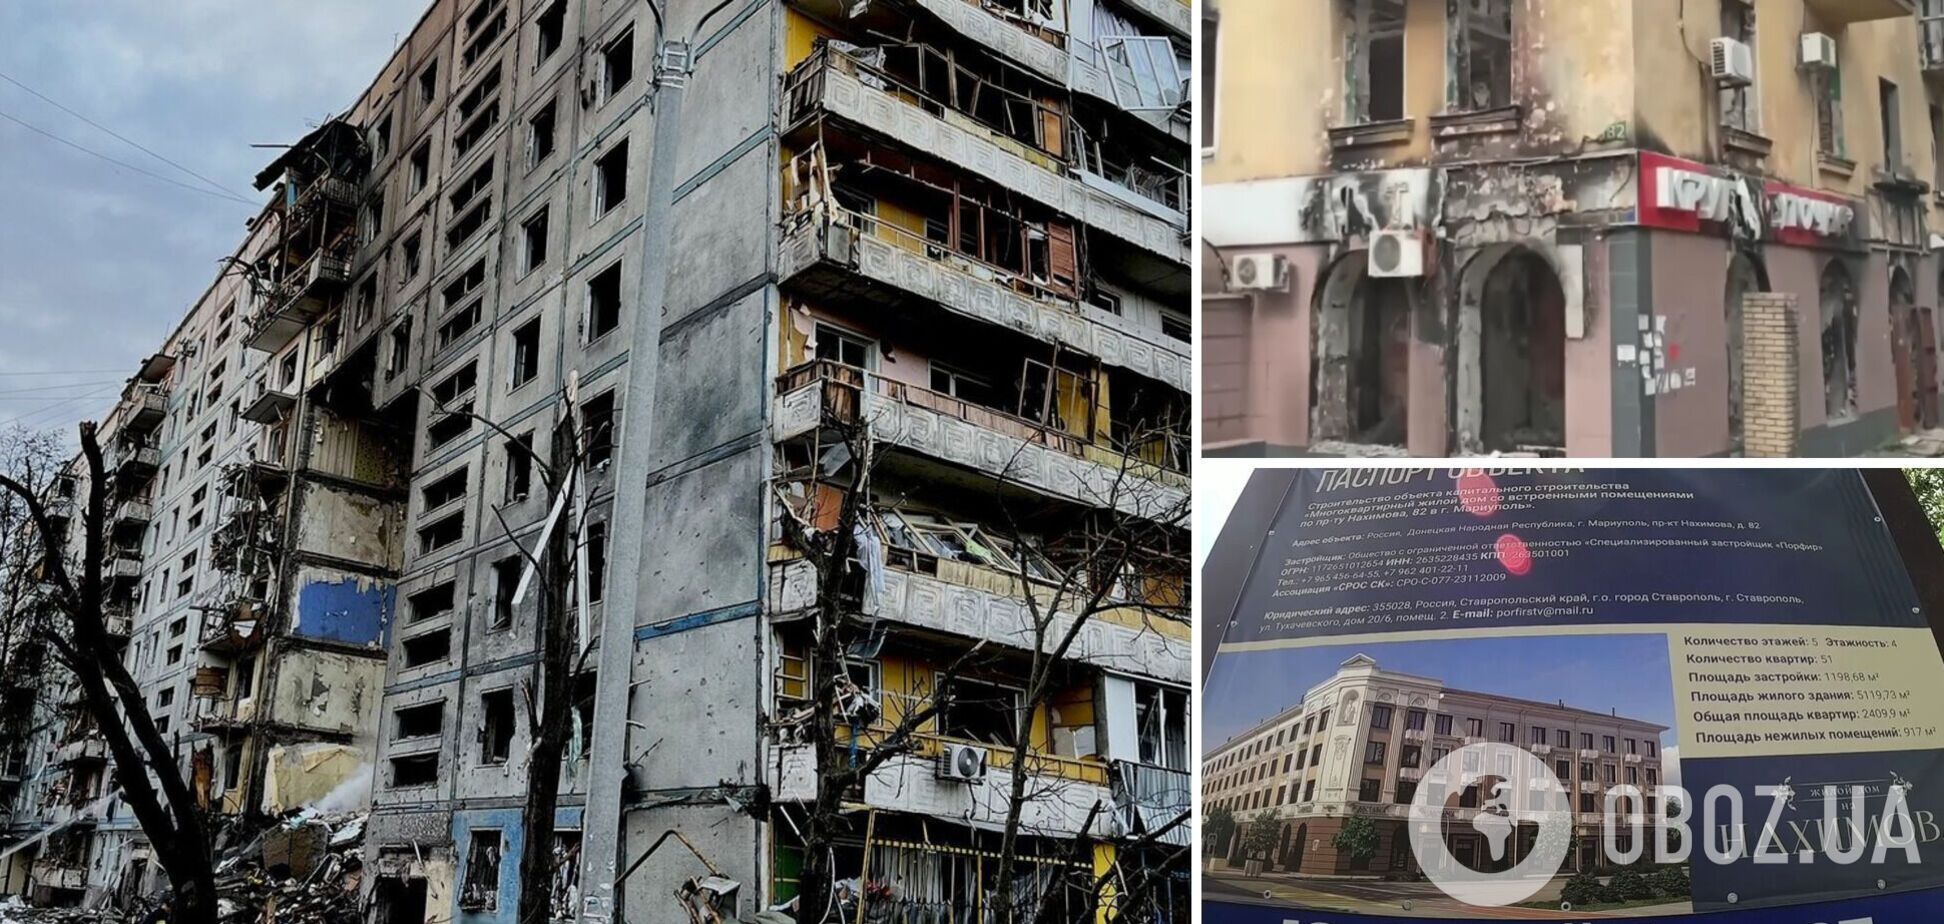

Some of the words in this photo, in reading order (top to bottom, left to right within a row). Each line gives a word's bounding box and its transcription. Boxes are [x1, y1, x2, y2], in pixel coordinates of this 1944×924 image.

[1607, 124, 1625, 139] 82
[1316, 468, 1437, 493] ПАСПОРТ
[1304, 500, 1416, 518] «Многоквартирный
[1418, 495, 1458, 507] жилой
[1462, 496, 1487, 506] дом
[1490, 494, 1505, 502] со
[1508, 490, 1598, 502] встроенными
[1600, 490, 1695, 500] помещениями
[1307, 493, 1392, 511] Строительство
[1394, 489, 1443, 503] объекта
[1446, 485, 1532, 497] капитального
[1535, 482, 1630, 493] строительства
[1299, 520, 1313, 529] по
[1347, 510, 1409, 523] Нахимова,
[1412, 508, 1427, 517] 82
[1440, 507, 1449, 515] г.
[1453, 502, 1536, 515] Мариуполь».
[1292, 539, 1321, 549] Адрес
[1322, 533, 1364, 544] объекта:
[1406, 526, 1456, 538] Донецкая
[1458, 522, 1509, 534] Народная
[1512, 519, 1576, 530] Республика,
[1588, 519, 1650, 529] Мариуполь,
[1652, 519, 1679, 529] пр-кт
[1681, 519, 1736, 530] Нахимова,
[1737, 521, 1746, 530] д.
[1748, 520, 1761, 530] 82
[1348, 550, 1396, 560] Общество
[1407, 542, 1478, 556] ограниченной
[1481, 539, 1582, 550] ответственностью
[1585, 537, 1709, 549] «Специализированный
[1711, 539, 1774, 550] застройщик
[1775, 541, 1823, 553] «Порфир»
[1281, 567, 1309, 577] ОГРН:
[1386, 557, 1413, 567] ИНН:
[1513, 549, 1569, 559] 263501001
[1384, 568, 1396, 577] +7
[1398, 567, 1417, 576] 962
[1419, 563, 1469, 574] 401-22-11
[1272, 586, 1331, 598] Ассоциация
[1333, 580, 1368, 592] «СРОС
[1370, 580, 1394, 589] СК»:
[1263, 606, 1333, 621] Юридический
[1335, 604, 1370, 616] адрес:
[1372, 600, 1413, 612] 355028,
[1415, 599, 1457, 610] Россия,
[1460, 593, 1556, 608] Ставропольский
[1559, 592, 1590, 604] край,
[1592, 594, 1612, 602] г.о.
[1614, 593, 1649, 603] город
[1651, 591, 1723, 603] Ставрополь,
[1725, 593, 1735, 602] г.
[1736, 593, 1805, 605] Ставрополь,
[1276, 618, 1341, 632] Тухачевского,
[1343, 617, 1365, 627] дом
[1368, 614, 1393, 625] 20/6,
[1396, 612, 1436, 623] помещ.
[1439, 610, 1449, 620] 2.
[1452, 607, 1494, 619] E-mail:
[1496, 605, 1594, 619] porfirstv@mail.ru
[1683, 636, 1759, 647] Количество
[1761, 637, 1810, 647] этажей:
[1812, 638, 1818, 647] 5
[1825, 637, 1890, 649] Этажность:
[1891, 639, 1898, 648] 4
[1686, 654, 1762, 665] Количество
[1765, 655, 1818, 667] квартир:
[1821, 654, 1833, 664] 51
[1688, 672, 1751, 684] Площадь
[1754, 671, 1822, 683] застройки:
[1824, 672, 1866, 683] 1198,68
[1691, 690, 1754, 703] Площадь
[1758, 692, 1805, 702] жилого
[1808, 691, 1854, 702] здания:
[1857, 690, 1897, 701] 5119,73
[1693, 710, 1741, 723] Общая
[1744, 711, 1804, 723] площадь
[1807, 709, 1860, 722] квартир:
[1862, 708, 1896, 720] 2409,9
[1695, 731, 1762, 744] Площадь
[1764, 731, 1826, 742] нежилых
[1828, 728, 1902, 741] помещений:
[1904, 727, 1922, 737] 917
[1718, 810, 1944, 860] НАХИМОВ
